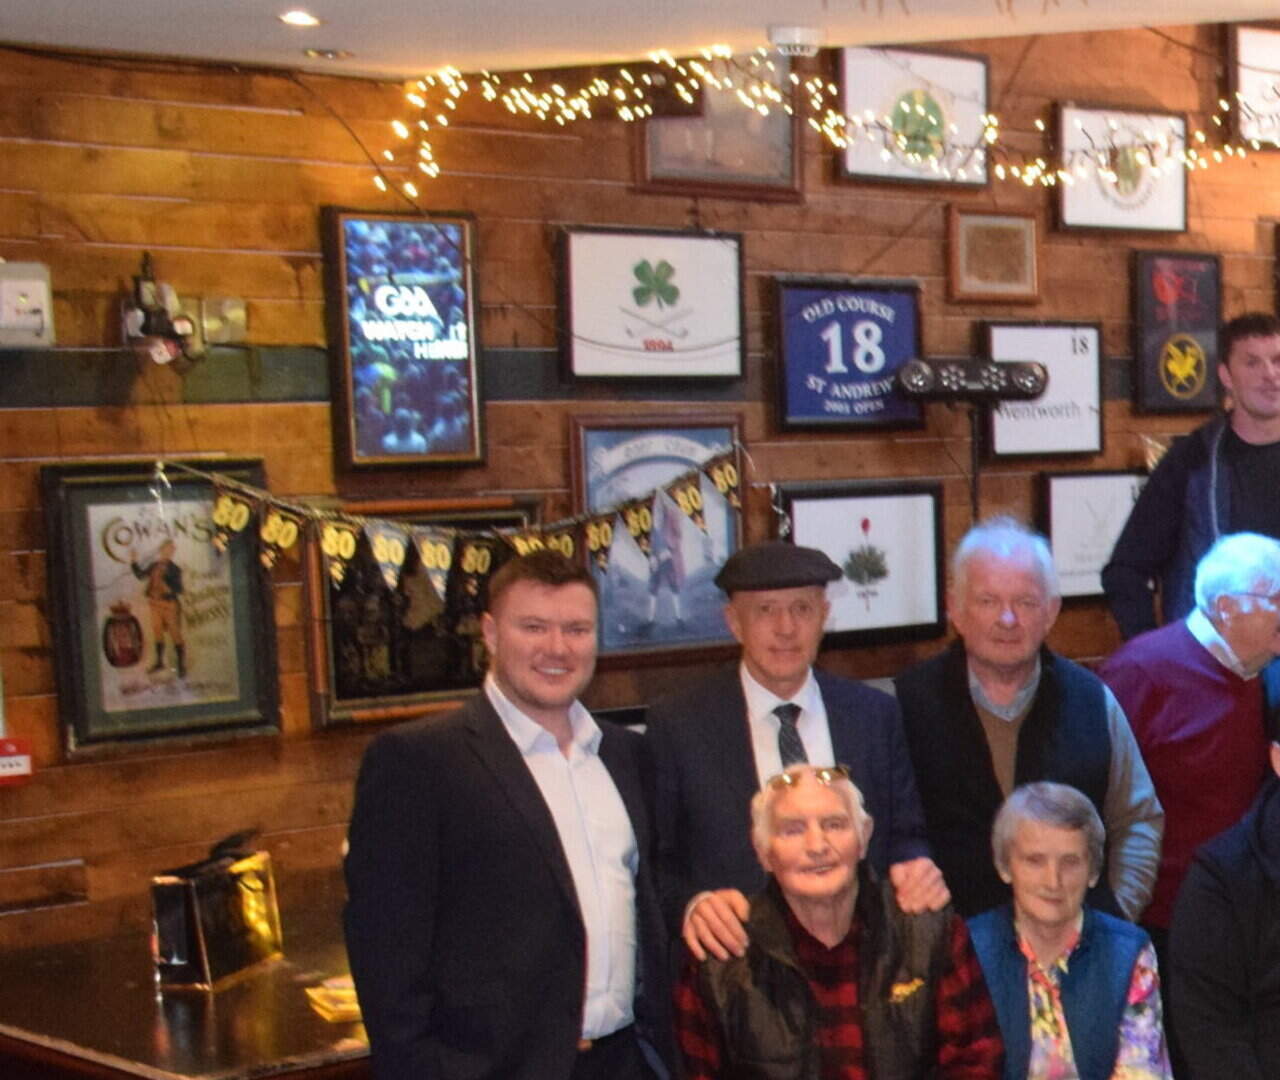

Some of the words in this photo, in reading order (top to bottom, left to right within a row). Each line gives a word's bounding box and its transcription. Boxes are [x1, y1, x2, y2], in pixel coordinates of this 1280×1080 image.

[802, 298, 834, 324] OLD
[835, 295, 896, 323] COURSE
[820, 320, 886, 375] 18
[1070, 336, 1090, 355] 18
[805, 374, 827, 394] ST
[830, 375, 896, 400] ANDREW
[711, 462, 738, 494] 80
[212, 496, 250, 533] 80
[675, 484, 703, 516] 80
[261, 512, 298, 549] 80
[585, 520, 613, 551] 80
[624, 506, 651, 537] 80
[321, 523, 356, 560] 80
[373, 534, 405, 566] 80
[420, 539, 451, 571] 80
[461, 544, 491, 574] 80
